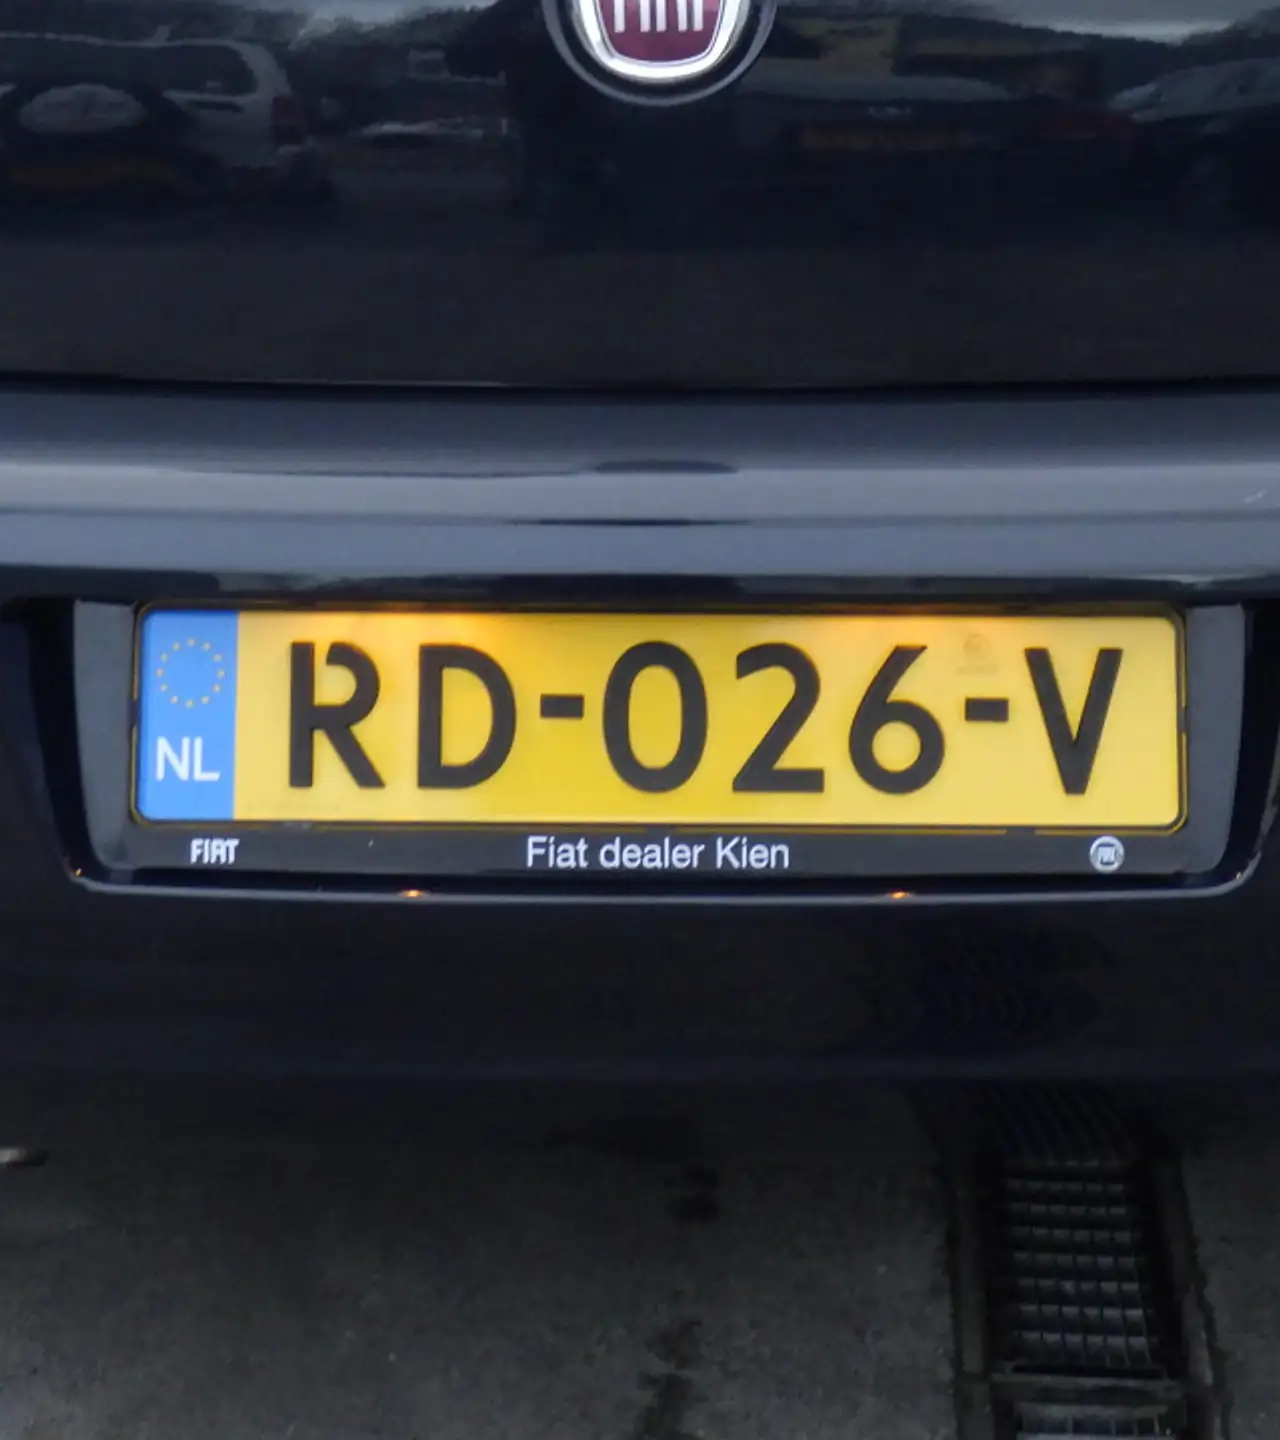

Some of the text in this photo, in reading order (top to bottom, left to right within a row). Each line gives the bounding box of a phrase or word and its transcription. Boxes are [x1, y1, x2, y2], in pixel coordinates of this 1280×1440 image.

[288, 640, 1125, 796] RD-026-V
[156, 735, 222, 782] NL
[190, 837, 240, 865] FIAT
[526, 836, 791, 869] Fiat dealer Kien
